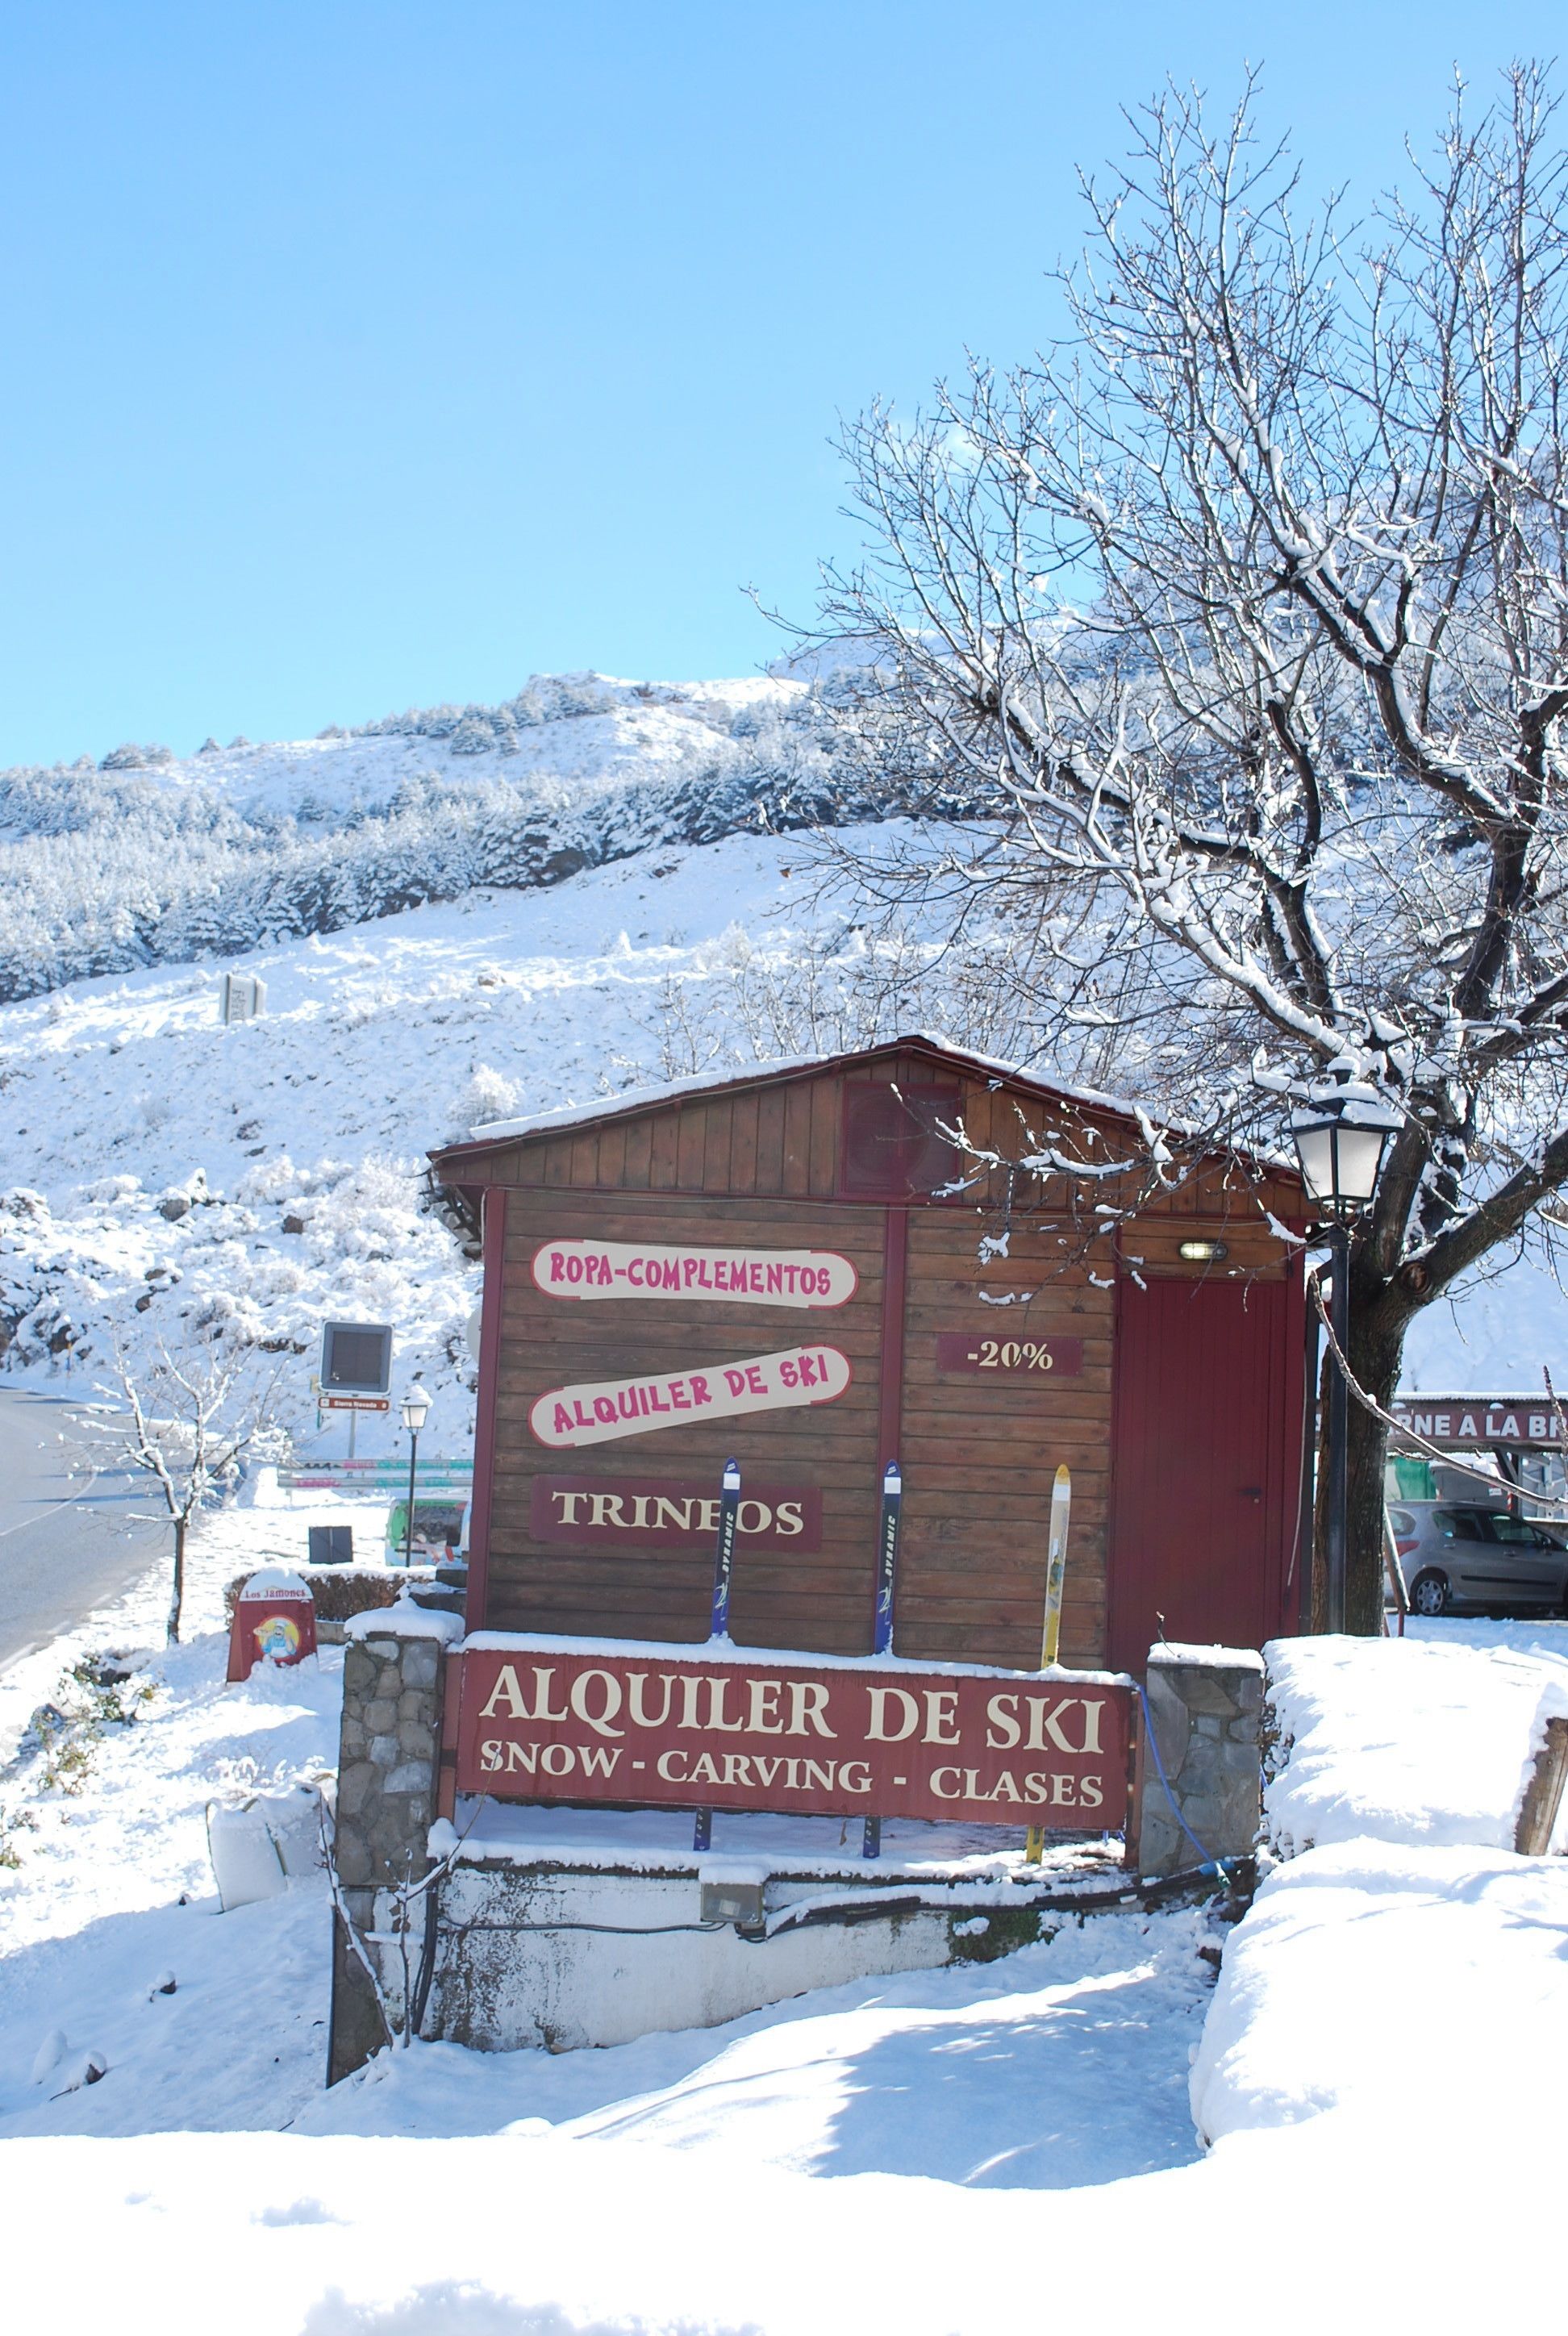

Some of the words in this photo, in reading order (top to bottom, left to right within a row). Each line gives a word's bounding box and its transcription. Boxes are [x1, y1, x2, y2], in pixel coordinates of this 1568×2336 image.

[550, 1252, 832, 1295] ROPA-COMPLEMENTOS
[967, 1341, 1053, 1370] -20%
[553, 1376, 712, 1433] ALQUILER
[723, 1365, 768, 1397] DE
[779, 1354, 829, 1388] SKI
[1458, 1414, 1478, 1437] A
[1486, 1414, 1520, 1437] LA
[552, 1491, 804, 1535] TRINEOS
[722, 1512, 734, 1573] DYNAMIC
[885, 1515, 896, 1576] DYNAMIC
[265, 1589, 306, 1597] Jamones
[479, 1665, 838, 1737] ALQUILER
[864, 1687, 961, 1746] DE
[986, 1694, 1106, 1754] SKI
[480, 1739, 624, 1778] SNOW
[657, 1750, 873, 1793] CARVING
[929, 1766, 1103, 1808] CLASES
